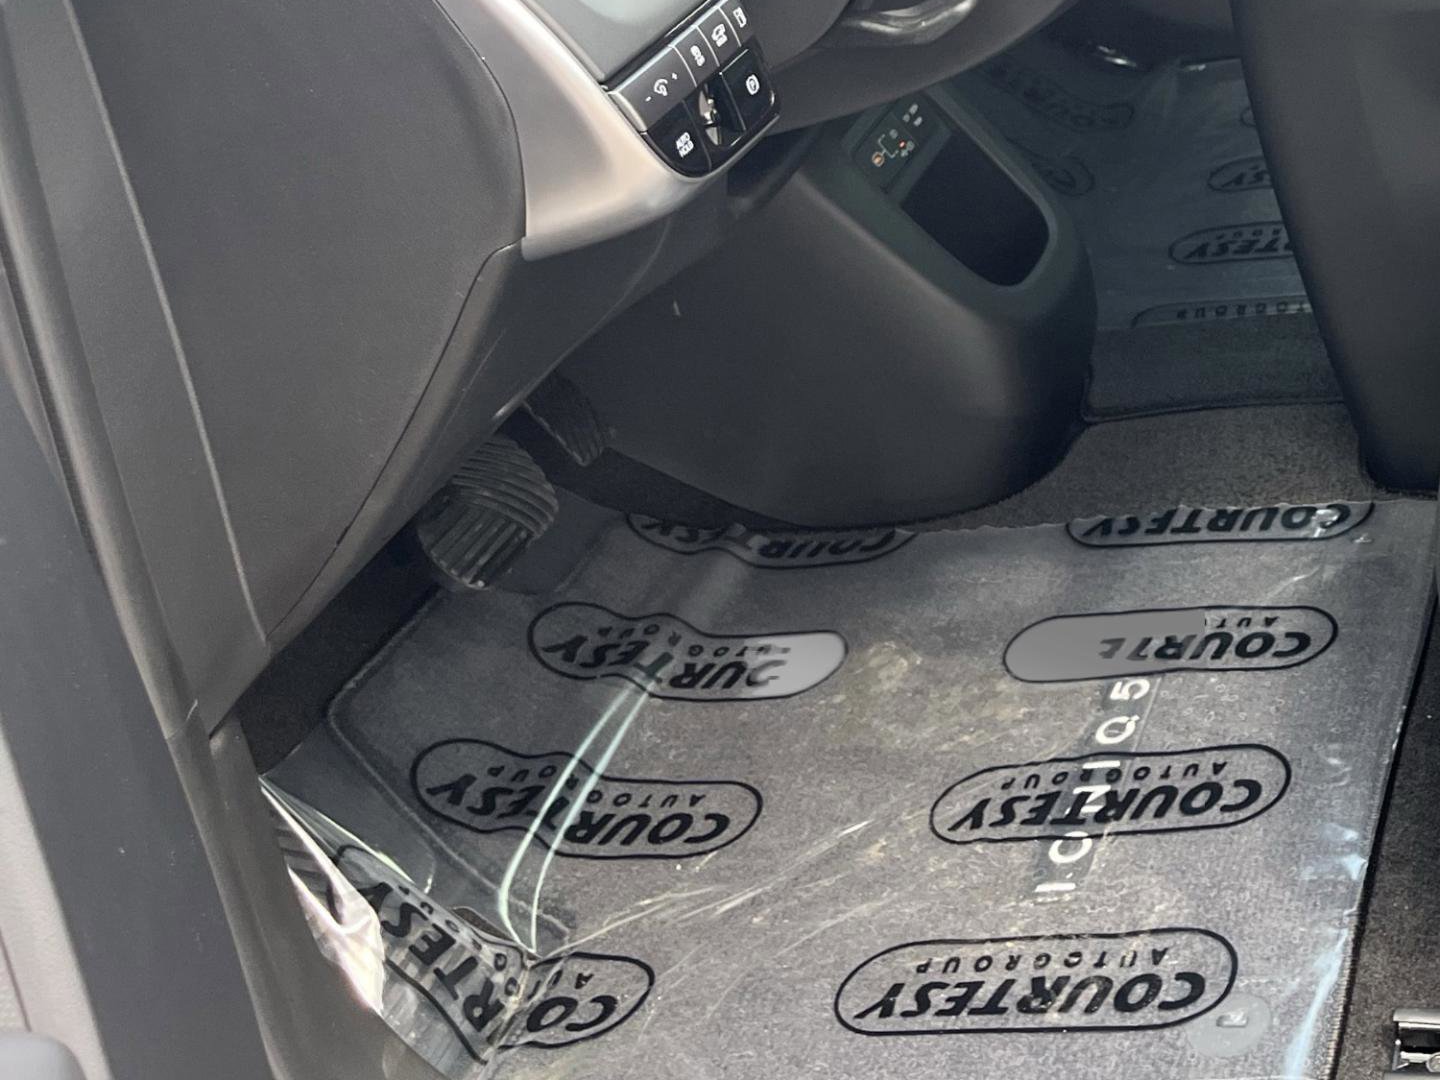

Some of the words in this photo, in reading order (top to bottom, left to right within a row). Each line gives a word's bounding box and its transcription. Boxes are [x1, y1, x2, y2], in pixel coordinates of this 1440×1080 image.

[947, 779, 1263, 832] COURTESY
[916, 947, 1169, 974] AUTOGROUP
[854, 971, 1206, 1019] COURTESY
